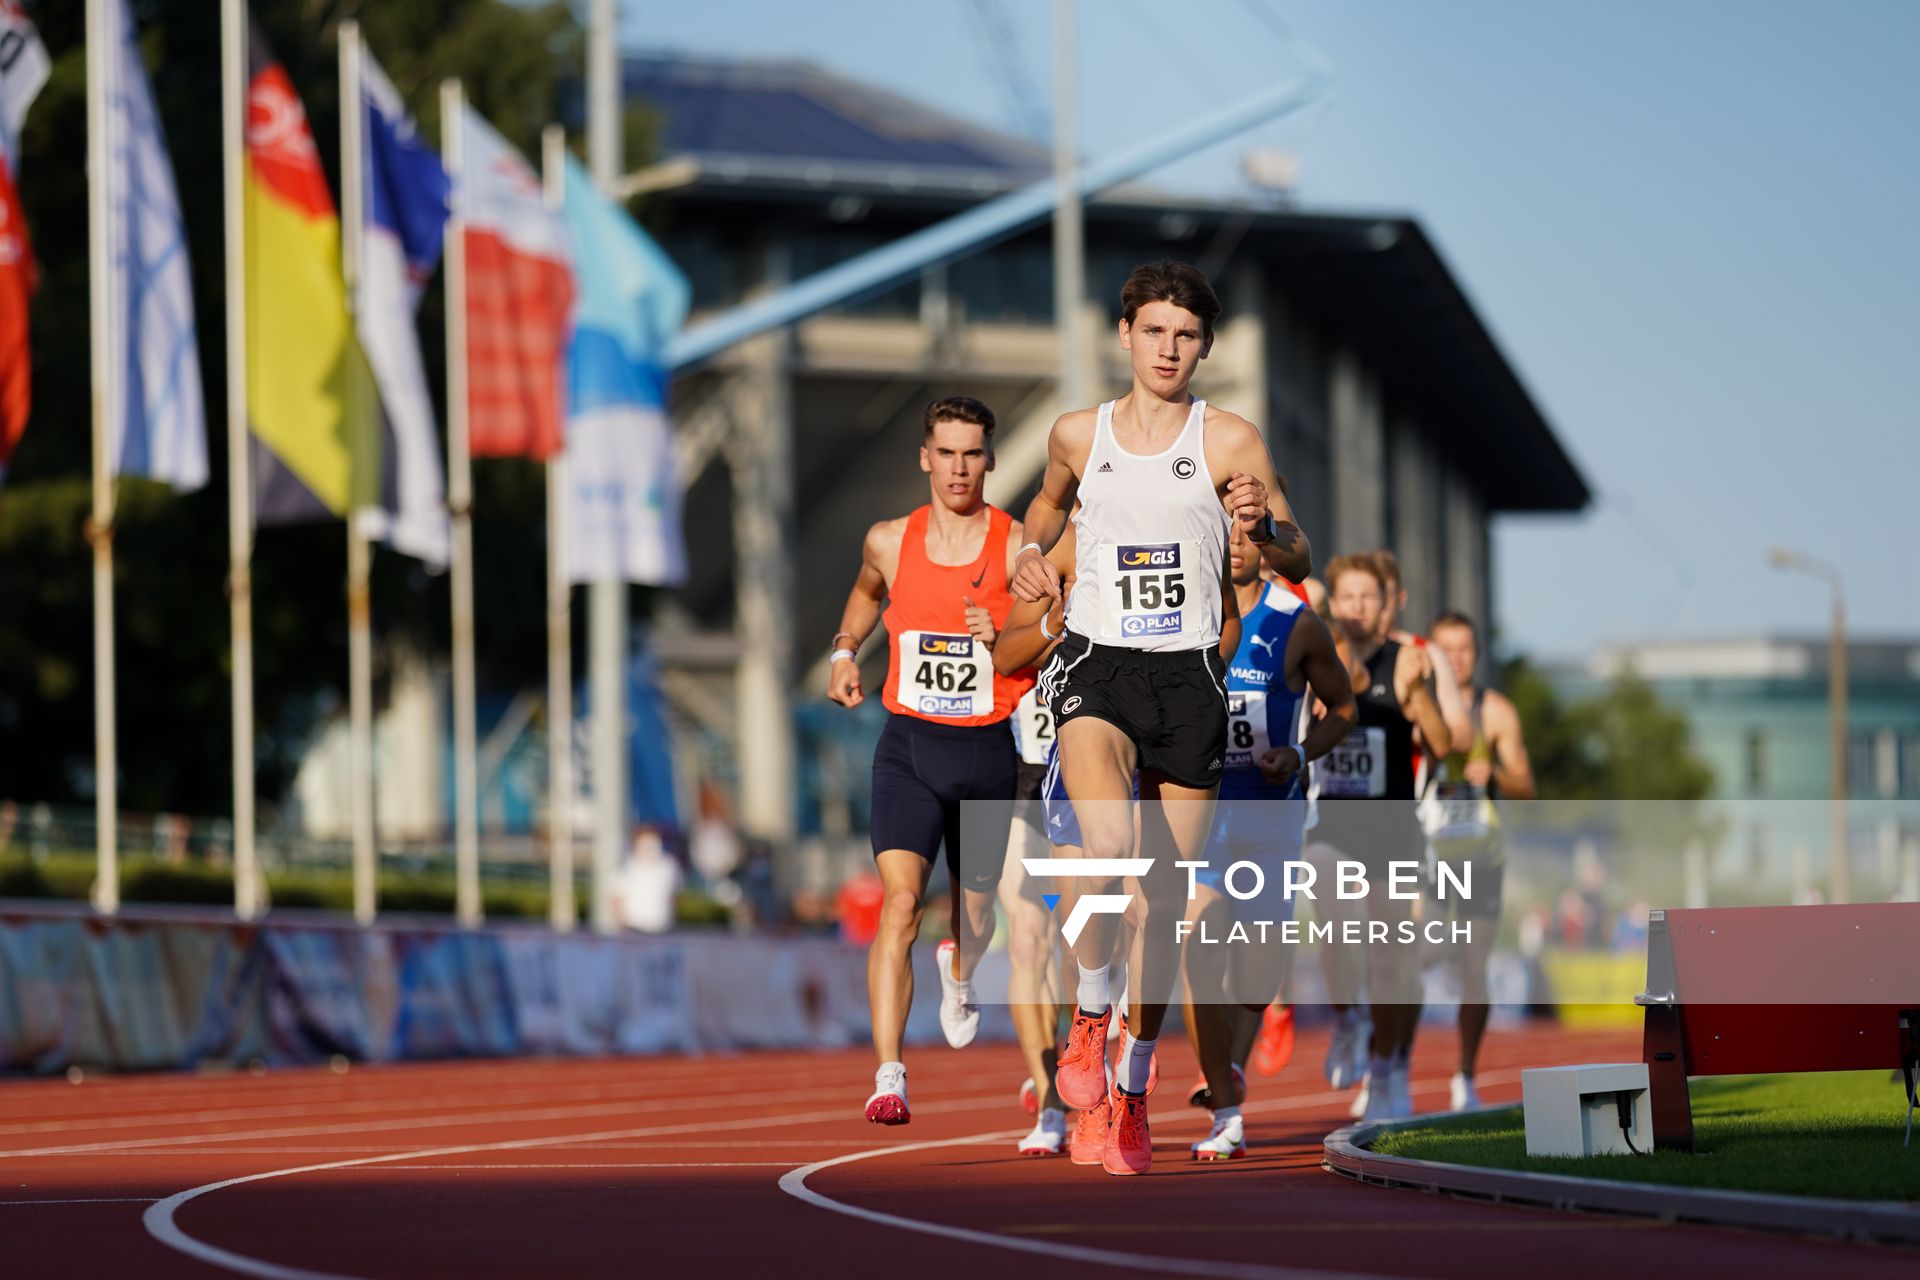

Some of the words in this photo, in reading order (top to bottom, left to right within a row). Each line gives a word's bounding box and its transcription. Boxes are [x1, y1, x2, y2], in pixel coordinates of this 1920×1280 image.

[1150, 551, 1176, 565] GLS
[1115, 573, 1186, 610] 155
[1147, 615, 1180, 628] PLAN
[946, 643, 970, 655] GLS
[915, 661, 978, 692] 462
[1230, 667, 1274, 681] VIACTIV
[940, 699, 971, 710] PLAN
[1323, 752, 1372, 776] 450
